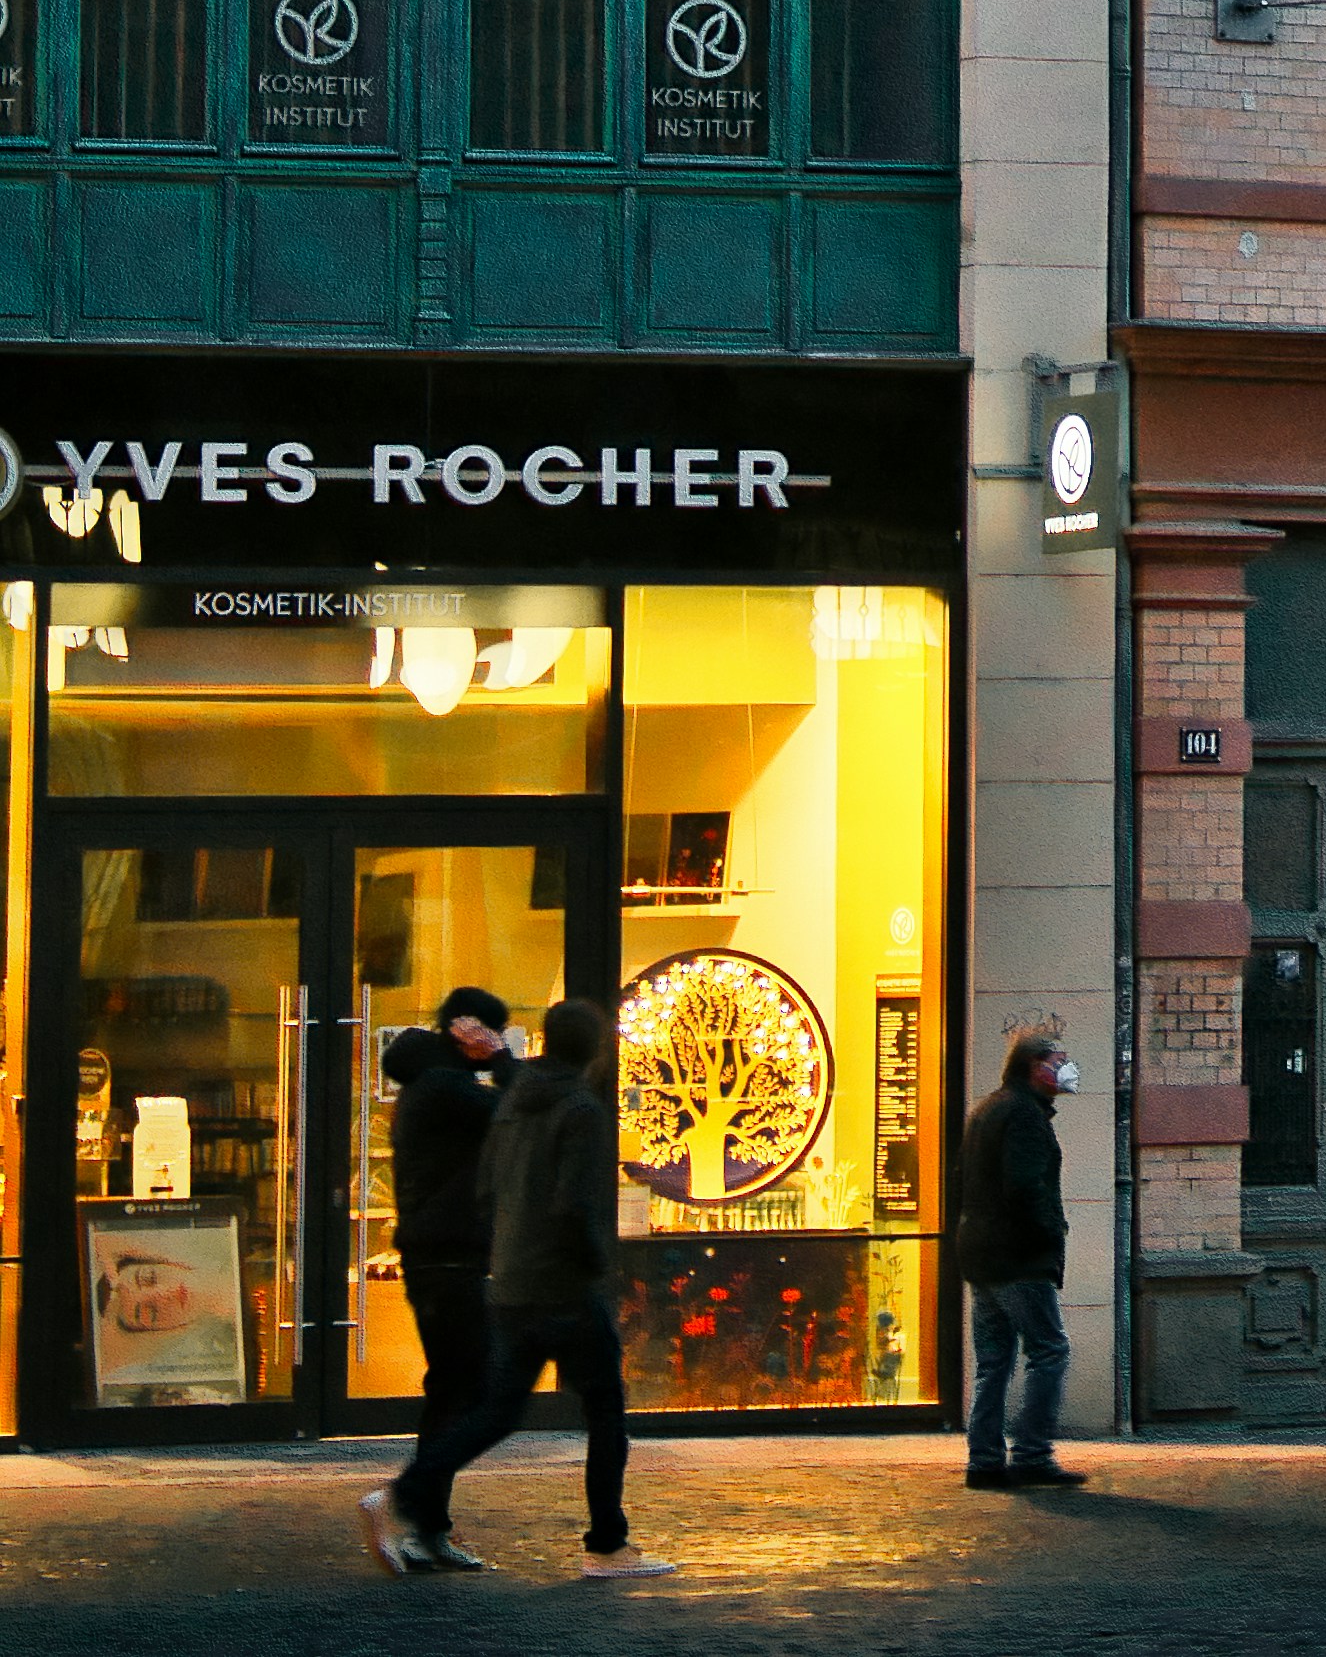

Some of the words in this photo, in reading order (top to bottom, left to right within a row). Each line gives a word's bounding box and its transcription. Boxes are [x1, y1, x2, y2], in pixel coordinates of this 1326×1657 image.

[258, 73, 375, 97] KOSMETIK
[651, 87, 763, 110] KOSMETIK
[265, 106, 368, 126] INSTITUT
[656, 118, 755, 139] INSTITUT
[56, 439, 317, 505] YVES
[372, 442, 791, 509] ROCHER
[194, 591, 468, 617] KOSMETIK-INSTITUT
[1187, 732, 1217, 755] 104
